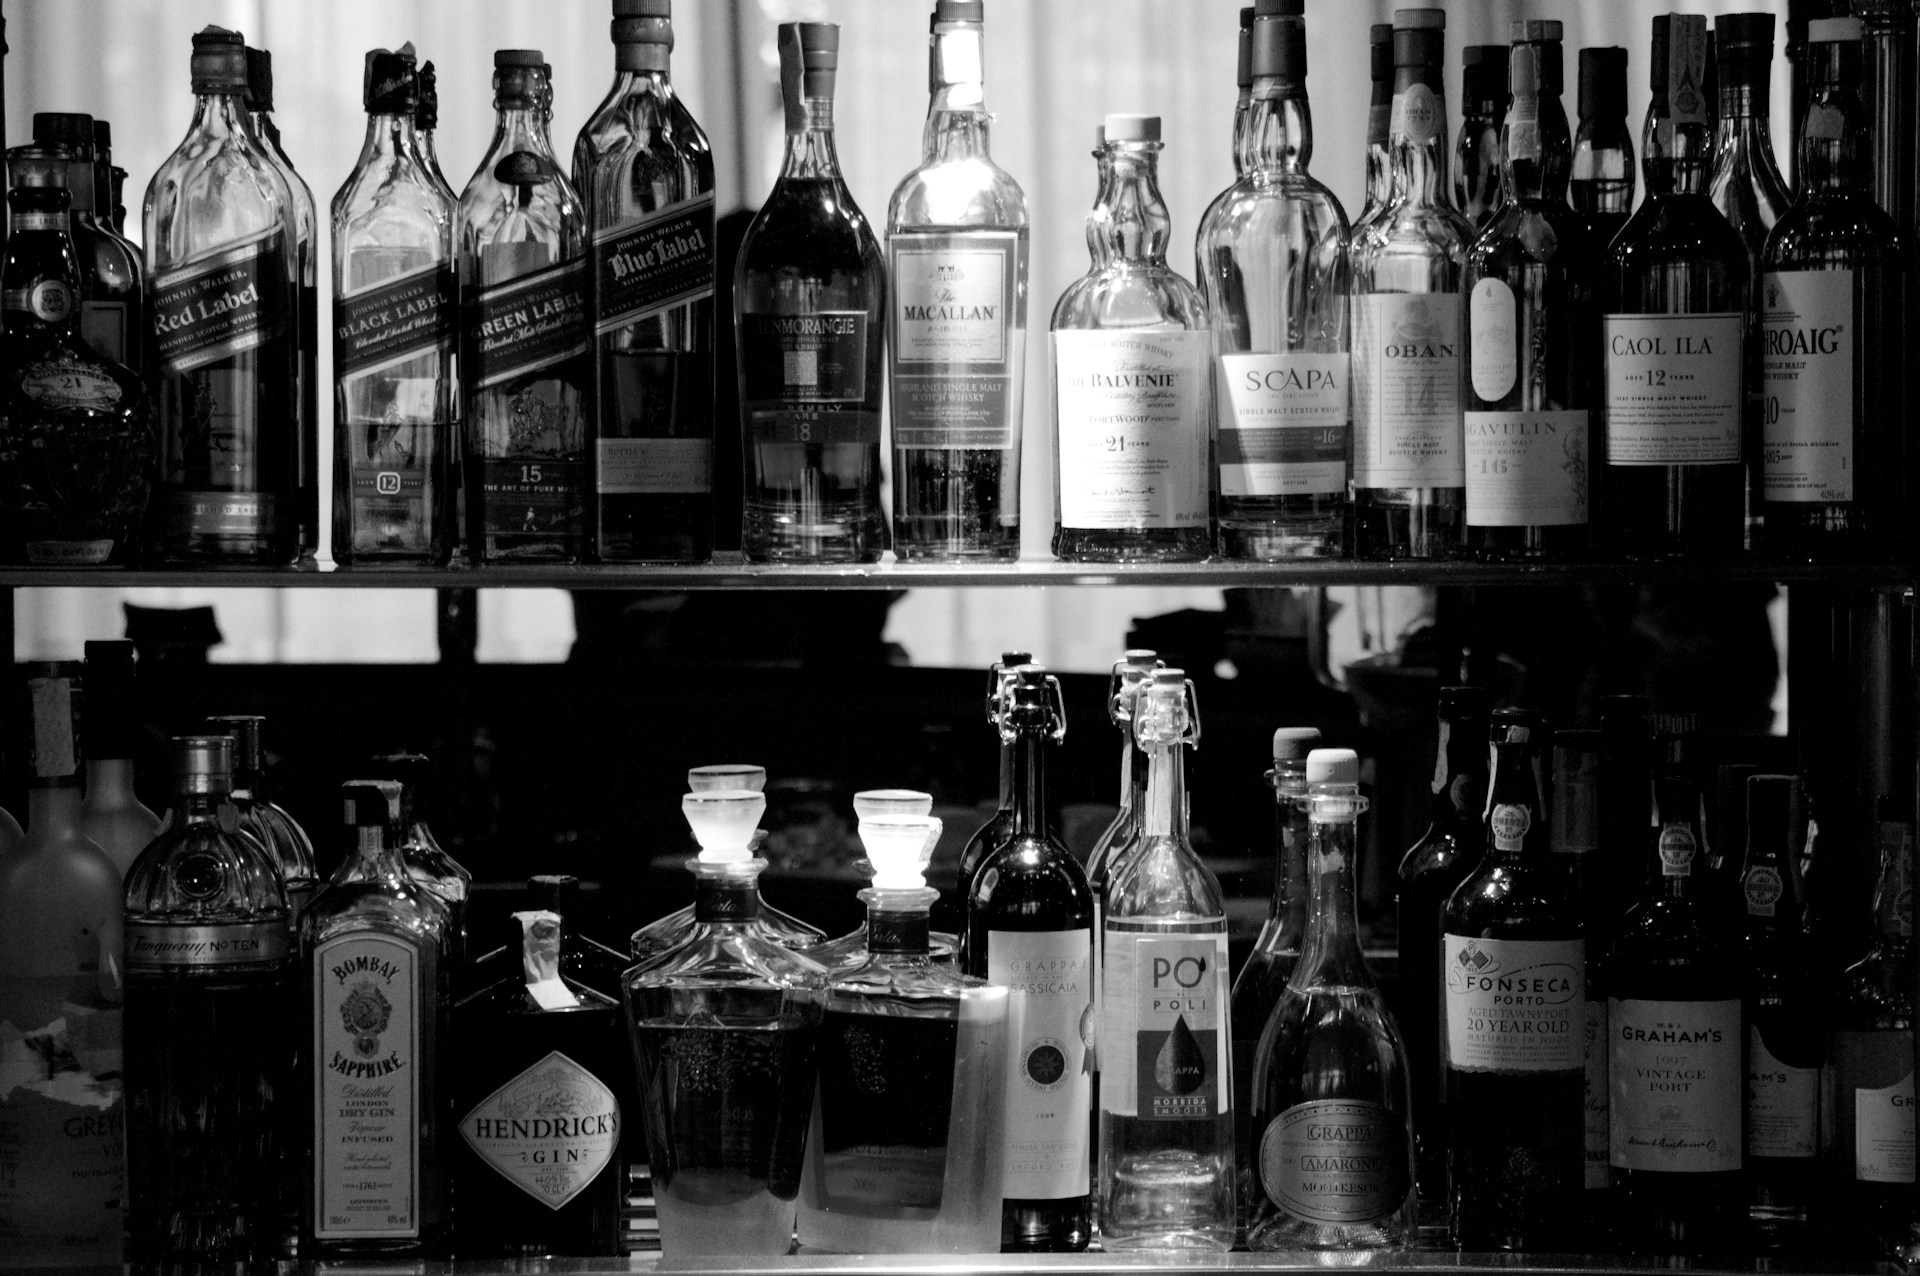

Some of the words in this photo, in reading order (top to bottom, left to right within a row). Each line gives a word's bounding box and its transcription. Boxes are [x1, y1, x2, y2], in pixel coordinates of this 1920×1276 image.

[616, 231, 655, 252] JOHNNIE
[656, 219, 692, 236] WALKER
[607, 249, 655, 281] Blue
[651, 228, 706, 266] Label
[154, 286, 199, 309] JOHNNIE
[153, 305, 197, 337] Red
[197, 282, 259, 321] Label
[532, 291, 584, 320] LABEL
[904, 304, 994, 321] MACALLAN
[338, 310, 392, 340] BLACK
[396, 292, 448, 319] LABEL
[196, 322, 229, 339] SCOTCH
[1384, 343, 1454, 358] OBAN
[1612, 335, 1668, 356] CAOL
[1675, 337, 1714, 356] ILA
[61, 376, 81, 389] 21
[1091, 373, 1176, 388] BALVENIE
[1245, 365, 1338, 392] SCAPA
[1646, 369, 1667, 387] 12
[943, 383, 978, 392] SINGLE
[980, 383, 1003, 392] MALT
[911, 393, 948, 402] SCOTCH
[950, 393, 985, 402] WHISKY
[1238, 407, 1265, 415] SINGLE
[1266, 407, 1288, 415] MALT
[1289, 406, 1319, 414] SCOTCH
[791, 422, 812, 442] 18
[1322, 429, 1337, 444] 16
[1106, 435, 1126, 451] 21
[1480, 458, 1508, 474] 16
[521, 464, 543, 484] 15
[383, 476, 397, 490] 12
[484, 484, 499, 492] THE
[501, 484, 517, 492] ART
[519, 484, 531, 492] OF
[231, 938, 260, 951] TEN
[332, 955, 401, 986] BOMBAY
[1010, 960, 1078, 973] GRAPPA
[1010, 982, 1079, 995] SASSICAIA
[1466, 976, 1571, 993] FONSECA
[1153, 999, 1206, 1011] POLI
[1494, 995, 1545, 1006] PORTO
[1466, 1007, 1498, 1018] AGED
[1466, 1018, 1484, 1032] 20
[1487, 1020, 1535, 1034] YEAR
[1536, 1020, 1571, 1033] OLD
[1466, 1033, 1519, 1043] MATURED
[1540, 1035, 1571, 1044] WOOD
[1622, 1026, 1723, 1043] GRAHAM'S
[329, 1051, 403, 1079] SAPPHIRE
[1656, 1054, 1688, 1067] 1997
[1636, 1068, 1707, 1080] VINTAGE
[340, 1084, 395, 1099] Distilled
[1650, 1082, 1694, 1092] PORT
[1153, 1098, 1207, 1106] MORBIDA
[338, 1108, 368, 1118] DRY
[369, 1108, 396, 1118] GIN
[1153, 1107, 1207, 1115] SMOOTH
[476, 1112, 618, 1139] HENDRICK'S
[1309, 1127, 1373, 1139] GRAPPA
[532, 1149, 579, 1164] GIN
[1305, 1158, 1380, 1170] AMARONE
[360, 1181, 377, 1190] 1761
[1302, 1182, 1380, 1193] MONTRESOR
